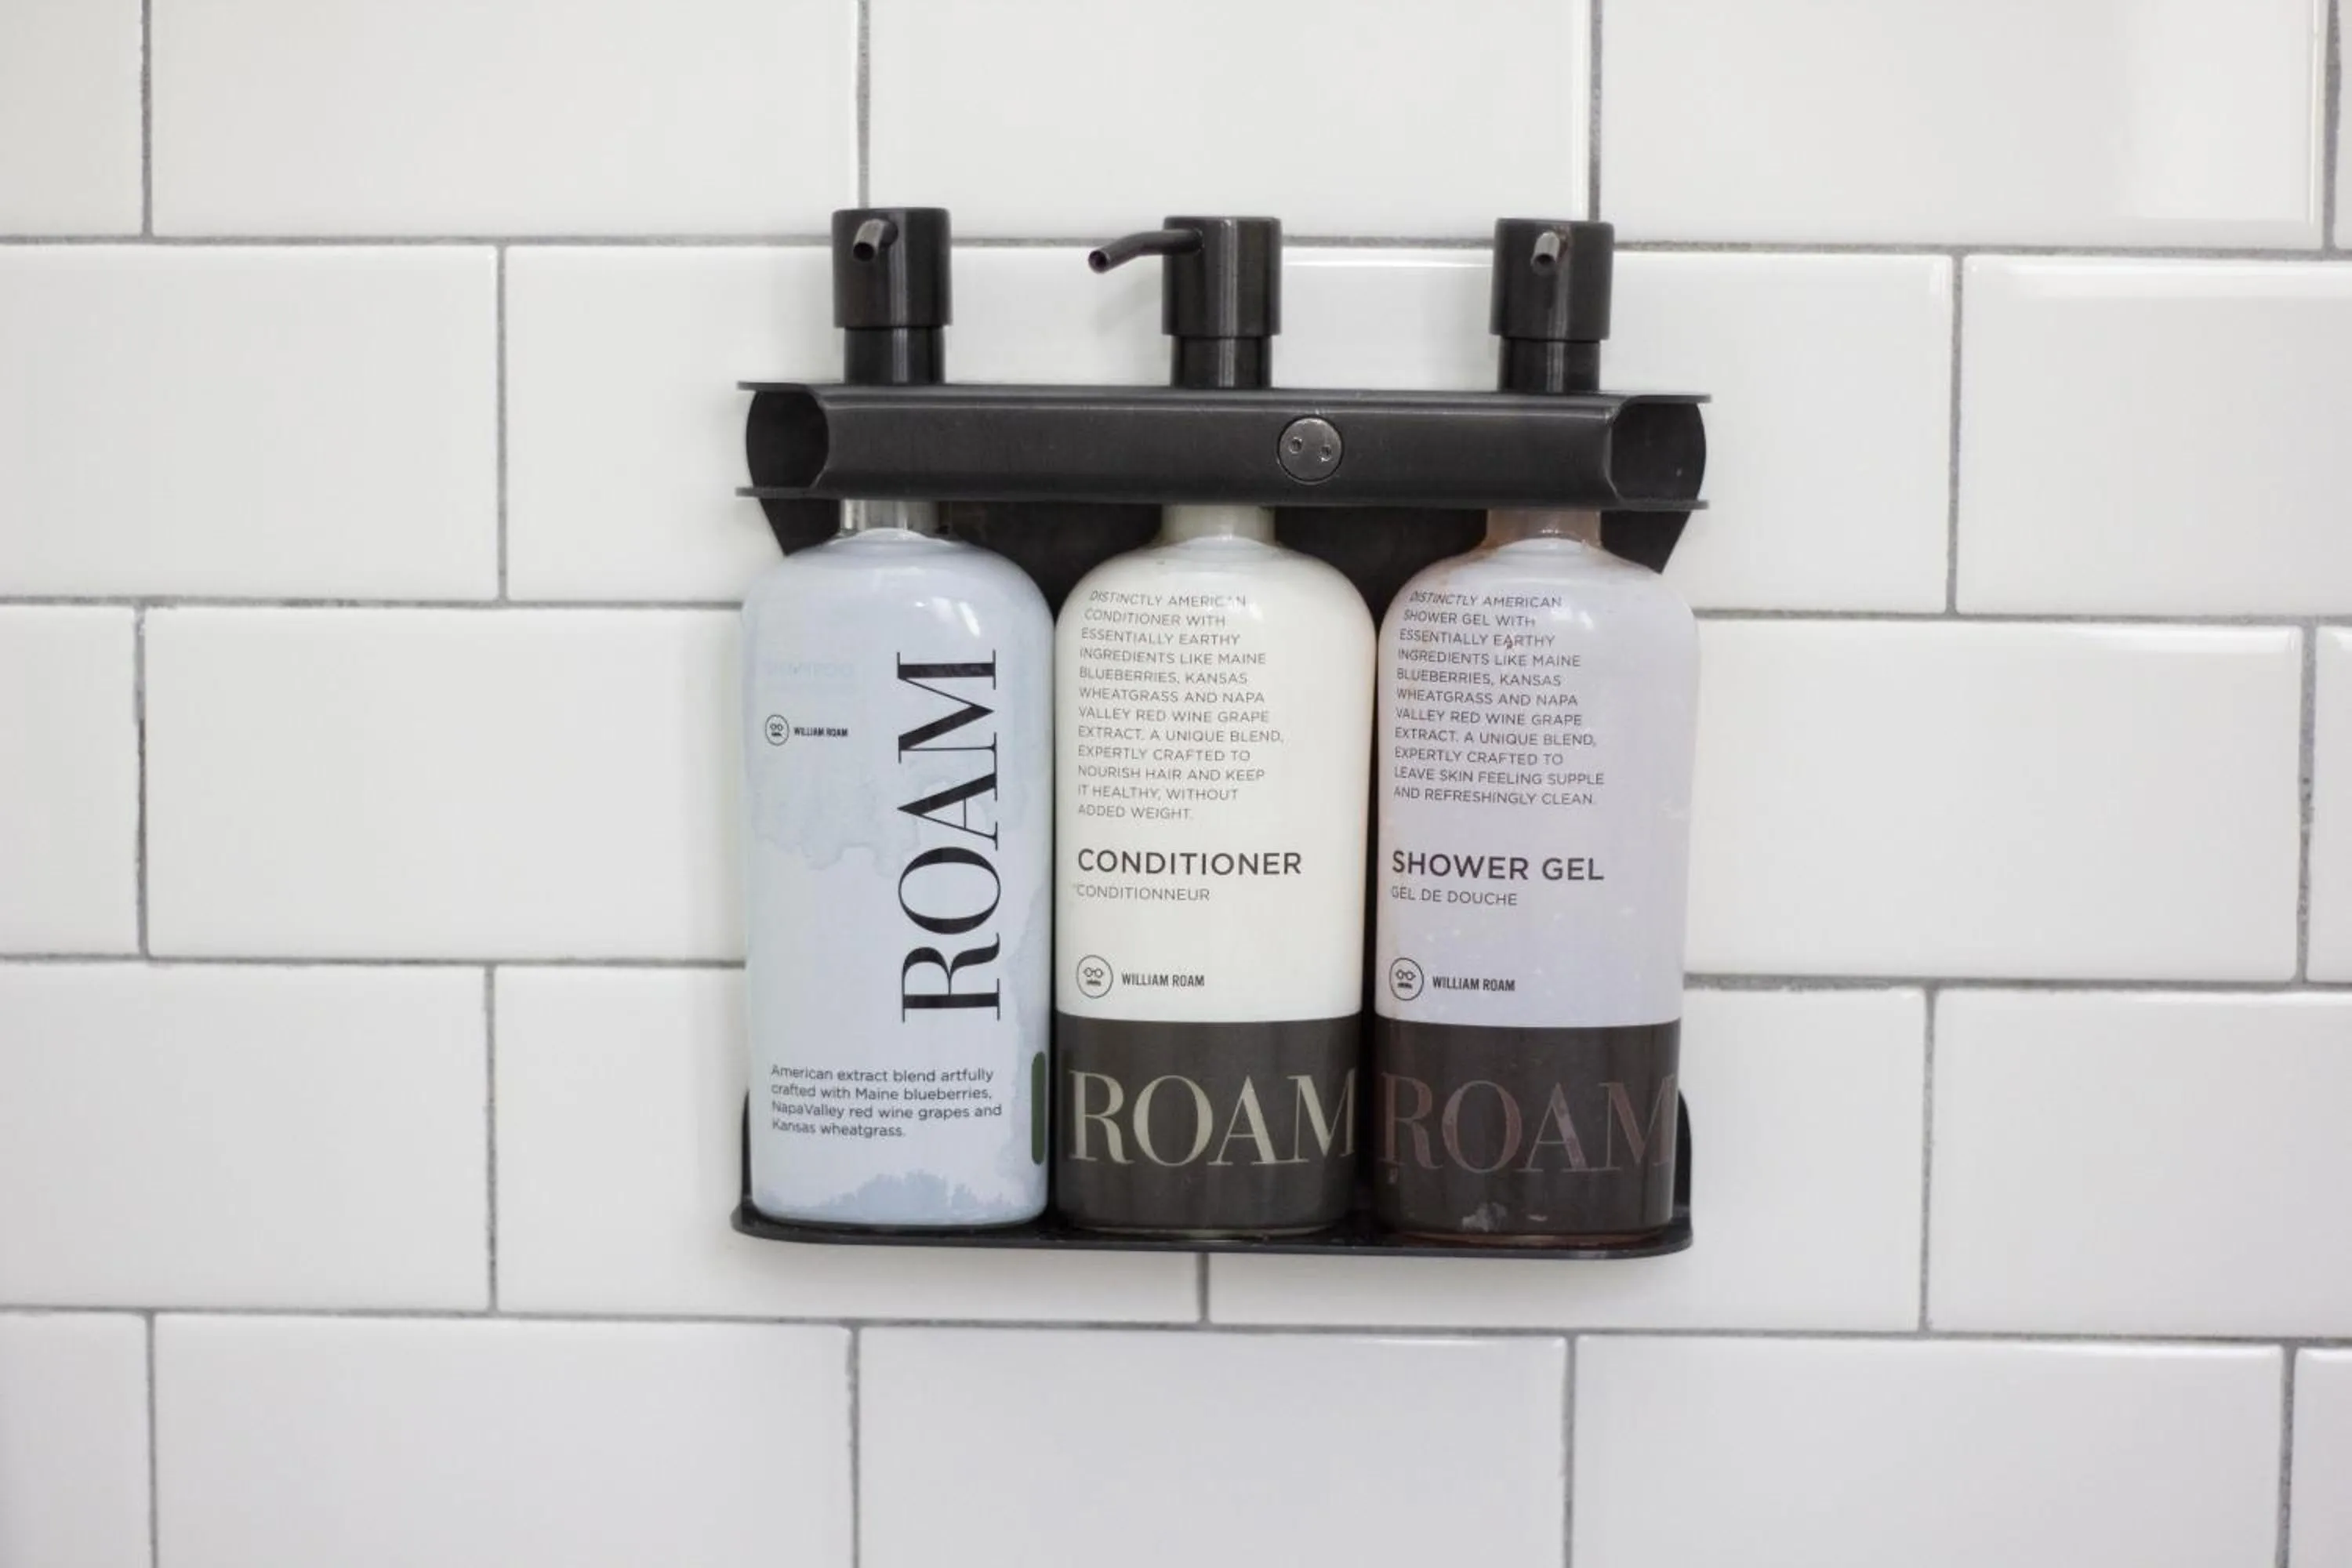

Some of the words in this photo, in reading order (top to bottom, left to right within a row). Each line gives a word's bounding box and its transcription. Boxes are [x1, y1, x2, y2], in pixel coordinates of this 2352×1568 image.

[1088, 590, 1163, 608] DISTINCTLY
[1409, 590, 1479, 607] DISTINCTLY
[1482, 595, 1562, 608] AMERICAN
[1083, 608, 1181, 627] CONDITIONER
[1185, 614, 1226, 627] WITH
[1403, 608, 1458, 625] SHOWER
[1461, 612, 1490, 626] GEL
[1494, 614, 1536, 627] WITH
[1081, 626, 1174, 645] ESSENTIALLY
[1178, 633, 1241, 646] EARTHY
[1399, 627, 1489, 646] ESSENTIALLY
[1493, 633, 1555, 650] EARTHY
[1080, 647, 1175, 665] INGREDIENTS
[1179, 652, 1213, 666] LIKE
[1218, 652, 1266, 665] MAINE
[1397, 648, 1490, 666] INGREDIENTS
[1494, 654, 1527, 667] LIKE
[1532, 654, 1581, 668] MAINE
[1185, 672, 1248, 685] KANSAS
[1499, 673, 1562, 687] KANSAS
[1079, 686, 1179, 703] WHEATGRASS
[1184, 691, 1218, 704] AND
[1221, 691, 1265, 704] NAPA
[1396, 688, 1494, 706] WHEATGRASS
[1497, 693, 1532, 706] AND
[1535, 693, 1578, 706] NAPA
[1078, 706, 1131, 720] VALLEY
[1135, 708, 1167, 723] RED
[1171, 710, 1212, 724] WINE
[1217, 710, 1269, 724] GRAPE
[1395, 707, 1446, 722] VALLEY
[1450, 710, 1481, 724] RED
[1485, 713, 1525, 726] WINE
[1530, 713, 1583, 727] GRAPE
[793, 726, 823, 737] WILLIAM
[825, 728, 849, 738] ROAM
[1149, 728, 1161, 741] A
[1165, 730, 1225, 743] UNIQUE
[1463, 731, 1475, 743] A
[1479, 731, 1538, 746] UNIQUE
[1077, 744, 1149, 760] EXPERTLY
[1152, 748, 1226, 762] CRAFTED
[1229, 750, 1251, 762] TO
[1394, 746, 1463, 763] EXPERTLY
[1466, 750, 1538, 766] CRAFTED
[1542, 753, 1564, 767] TO
[1077, 764, 1142, 779] NOURISH
[1145, 768, 1182, 781] HAIR
[1186, 768, 1221, 782] AND
[1225, 768, 1265, 782] KEEP
[1394, 765, 1436, 781] LEAVE
[1439, 768, 1474, 782] SKIN
[1477, 770, 1543, 786] FEELING
[1547, 772, 1605, 786] SUPPLE
[1077, 783, 1090, 796] IT
[1165, 787, 1239, 801] WITHOUT
[1393, 786, 1421, 800] AND
[1424, 787, 1537, 806] REFRESHINGLY
[1077, 804, 1127, 818] ADDED
[896, 649, 1001, 1023] ROAM
[1077, 848, 1301, 876] CONDITIONER
[1392, 849, 1530, 880] SHOWER
[1541, 857, 1605, 881] GEL
[1076, 884, 1210, 902] CONDITIONNEUR
[1390, 885, 1416, 902] GEL
[1421, 887, 1442, 903] DE
[1446, 890, 1518, 907] DOUCHE
[1121, 973, 1169, 987] WILLIAM
[1171, 974, 1205, 988] ROAM
[1432, 976, 1480, 990] WILLIAM
[1482, 978, 1515, 992] ROAM
[770, 1064, 833, 1081] American
[836, 1069, 888, 1083] extract
[892, 1069, 937, 1083] blend
[940, 1067, 994, 1083] artfully
[771, 1083, 817, 1098] crafted
[819, 1087, 851, 1099] with
[855, 1087, 899, 1101] Maine
[848, 1105, 873, 1119] red
[877, 1107, 914, 1120] wine
[917, 1108, 971, 1122] grapes
[974, 1103, 1003, 1118] and
[1068, 1067, 1356, 1167] ROAM
[771, 1118, 817, 1134] Kansas
[1377, 1071, 1676, 1174] ROAM
